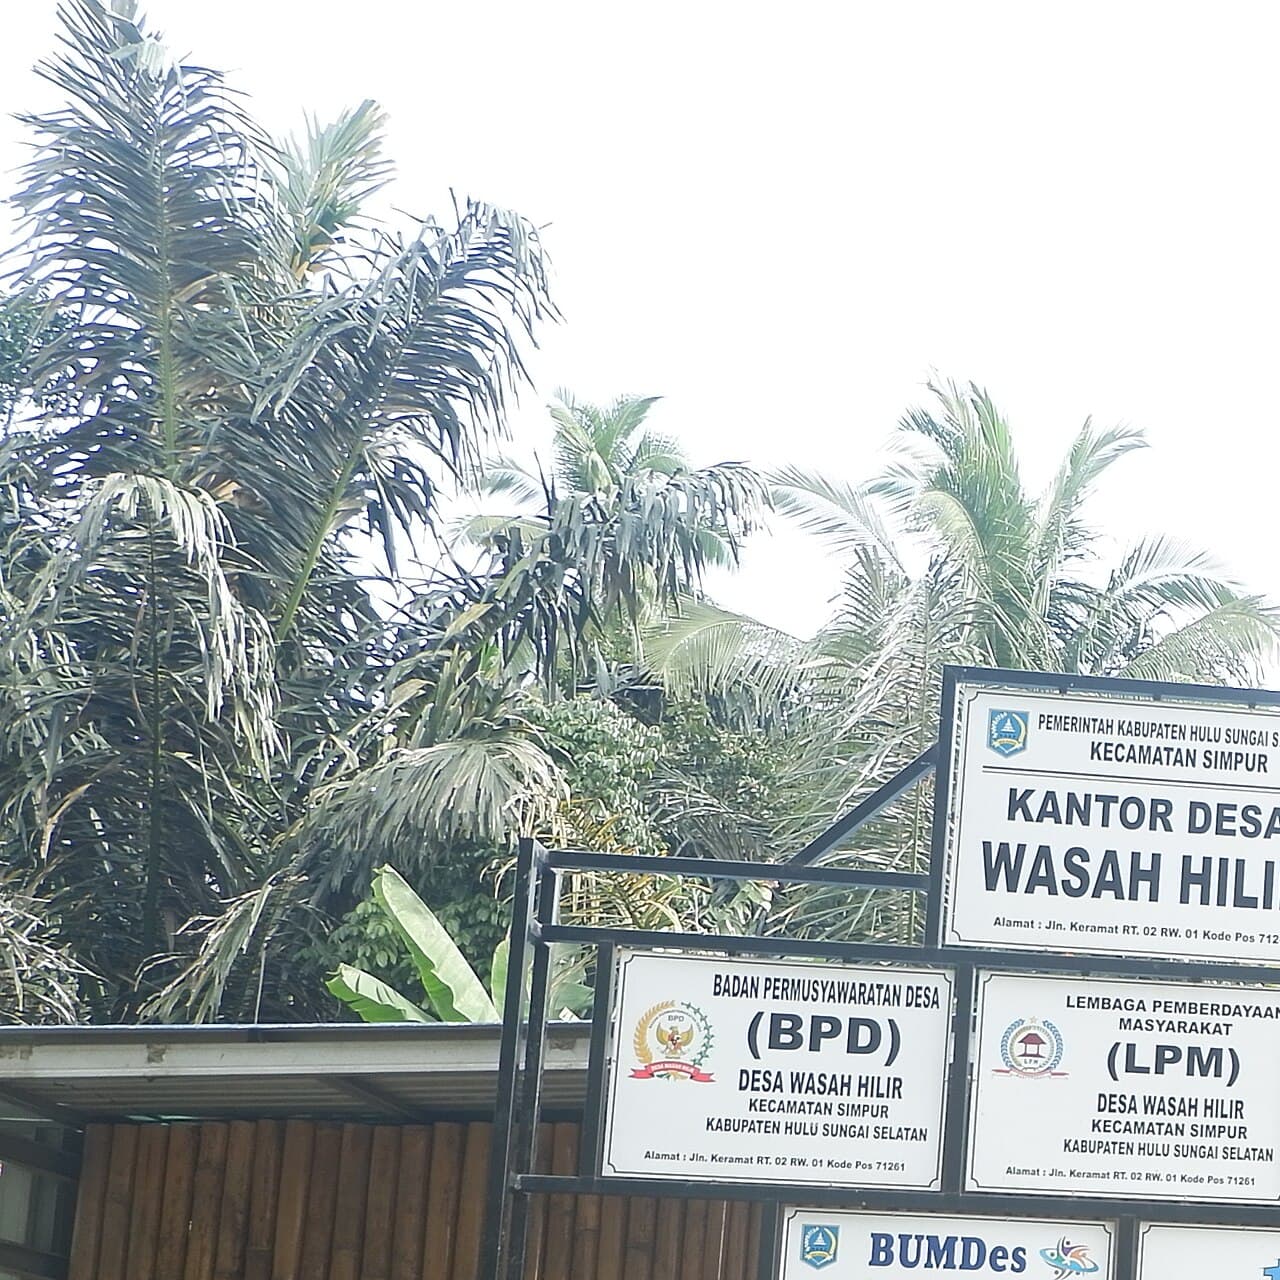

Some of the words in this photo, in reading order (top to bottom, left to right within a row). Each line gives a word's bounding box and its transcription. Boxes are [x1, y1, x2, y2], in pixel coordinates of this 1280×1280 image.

[1038, 713, 1114, 736] PEMERINTAH
[1117, 719, 1187, 741] KABUPATEN
[1189, 724, 1222, 744] HULU
[1224, 727, 1269, 747] SUNGAI
[1090, 740, 1197, 768] KECAMATAN
[1202, 749, 1268, 774] SIMPUR
[1007, 787, 1174, 833] KANTOR
[981, 840, 1162, 903] WASAH
[993, 916, 1035, 929] Alamat
[1044, 920, 1066, 931] Jln.
[1069, 921, 1119, 935] Keramat
[1122, 924, 1140, 936] RT.
[1143, 926, 1157, 937] 02
[1160, 927, 1182, 938] RW.
[1185, 928, 1198, 940] 01
[1202, 929, 1232, 942] Kode
[1234, 931, 1256, 943] Pos
[712, 973, 760, 999] BADAN
[763, 976, 902, 1007] PERMUSYAWARATAN
[905, 985, 940, 1010] DESA
[1066, 995, 1147, 1013] LEMBAGA
[747, 1011, 901, 1067] (BPD)
[1119, 1017, 1233, 1036] MASYARAKAT
[1107, 1041, 1240, 1088] (LPM)
[738, 1068, 784, 1094] DESA
[790, 1071, 852, 1097] WASAH
[857, 1074, 903, 1100] HILIR
[748, 1098, 833, 1116] KECAMATAN
[836, 1102, 889, 1119] SIMPUR
[1097, 1092, 1138, 1115] DESA
[1142, 1094, 1199, 1118] WASAH
[1203, 1098, 1244, 1120] HILIR
[705, 1117, 781, 1135] KABUPATEN
[784, 1120, 819, 1137] HULU
[821, 1122, 870, 1139] SUNGAI
[872, 1125, 928, 1142] SELATAN
[1091, 1118, 1185, 1137] KECAMATAN
[1189, 1123, 1248, 1140] SIMPUR
[643, 1150, 680, 1161] Alamat
[688, 1152, 708, 1163] Jln.
[710, 1153, 754, 1165] Keramat
[756, 1155, 772, 1166] RT.
[774, 1156, 788, 1166] 02
[790, 1157, 809, 1167] RW.
[811, 1158, 823, 1168] 01
[826, 1159, 853, 1169] Kode
[854, 1160, 873, 1170] Pos
[875, 1161, 905, 1172] 71261
[1063, 1138, 1135, 1156] KABUPATEN
[1137, 1142, 1170, 1158] HULU
[1173, 1143, 1219, 1160] SUNGAI
[1221, 1146, 1274, 1162] SELATAN
[1005, 1166, 1040, 1177] Alamat
[1048, 1168, 1067, 1178] Jln.
[1069, 1168, 1111, 1180] Keramat
[1112, 1170, 1128, 1180] RT.
[1130, 1171, 1143, 1181] 02
[1145, 1172, 1163, 1182] RW.
[1165, 1173, 1177, 1183] 01
[1180, 1174, 1205, 1184] Kode
[1207, 1175, 1225, 1185] Pos
[1226, 1175, 1255, 1186] 71261
[868, 1232, 1027, 1274] BUMDes
